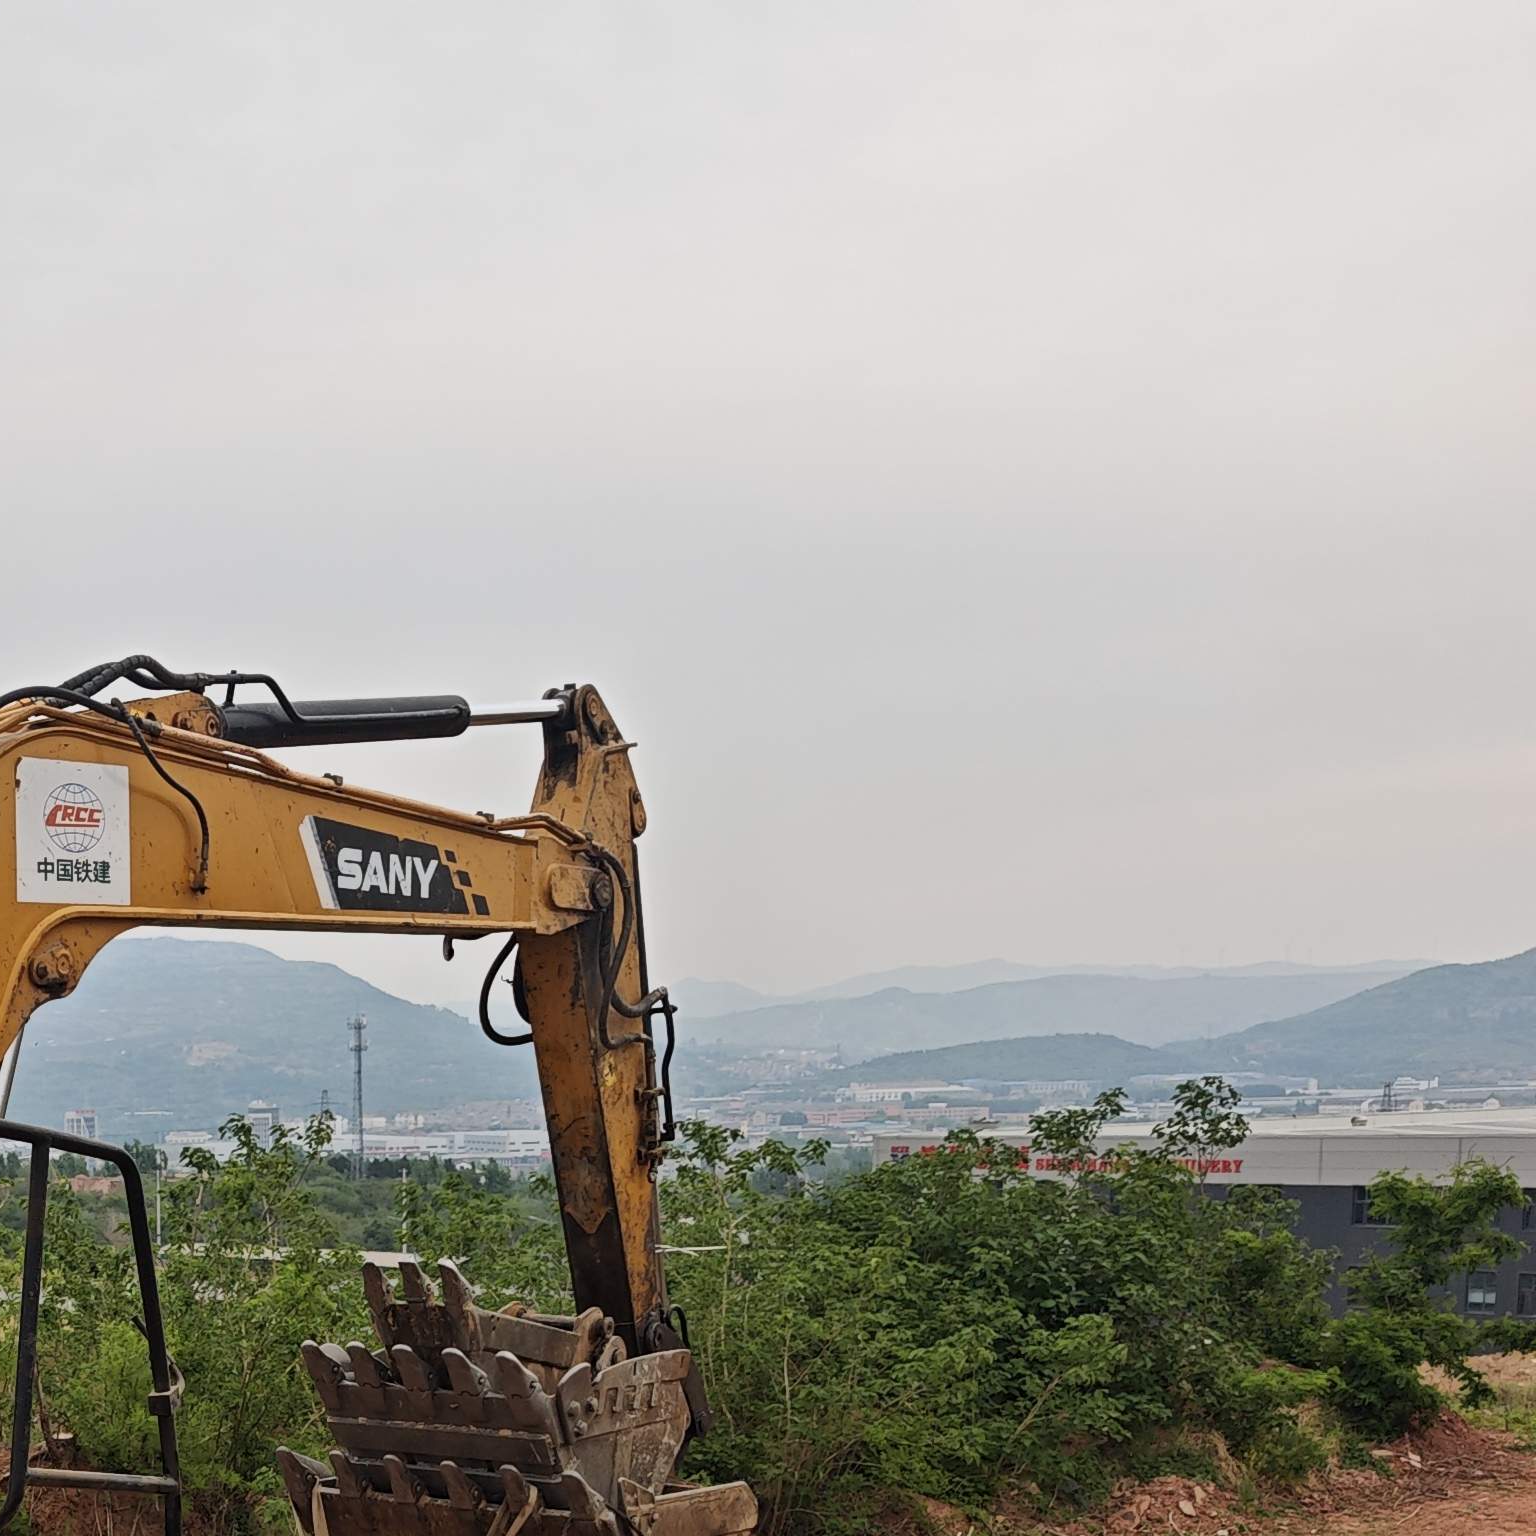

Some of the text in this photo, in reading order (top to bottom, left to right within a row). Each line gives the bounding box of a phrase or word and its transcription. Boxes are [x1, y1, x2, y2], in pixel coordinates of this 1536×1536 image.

[45, 804, 102, 827] CRCC
[37, 857, 111, 884] 中国铁建
[337, 847, 439, 899] SANY
